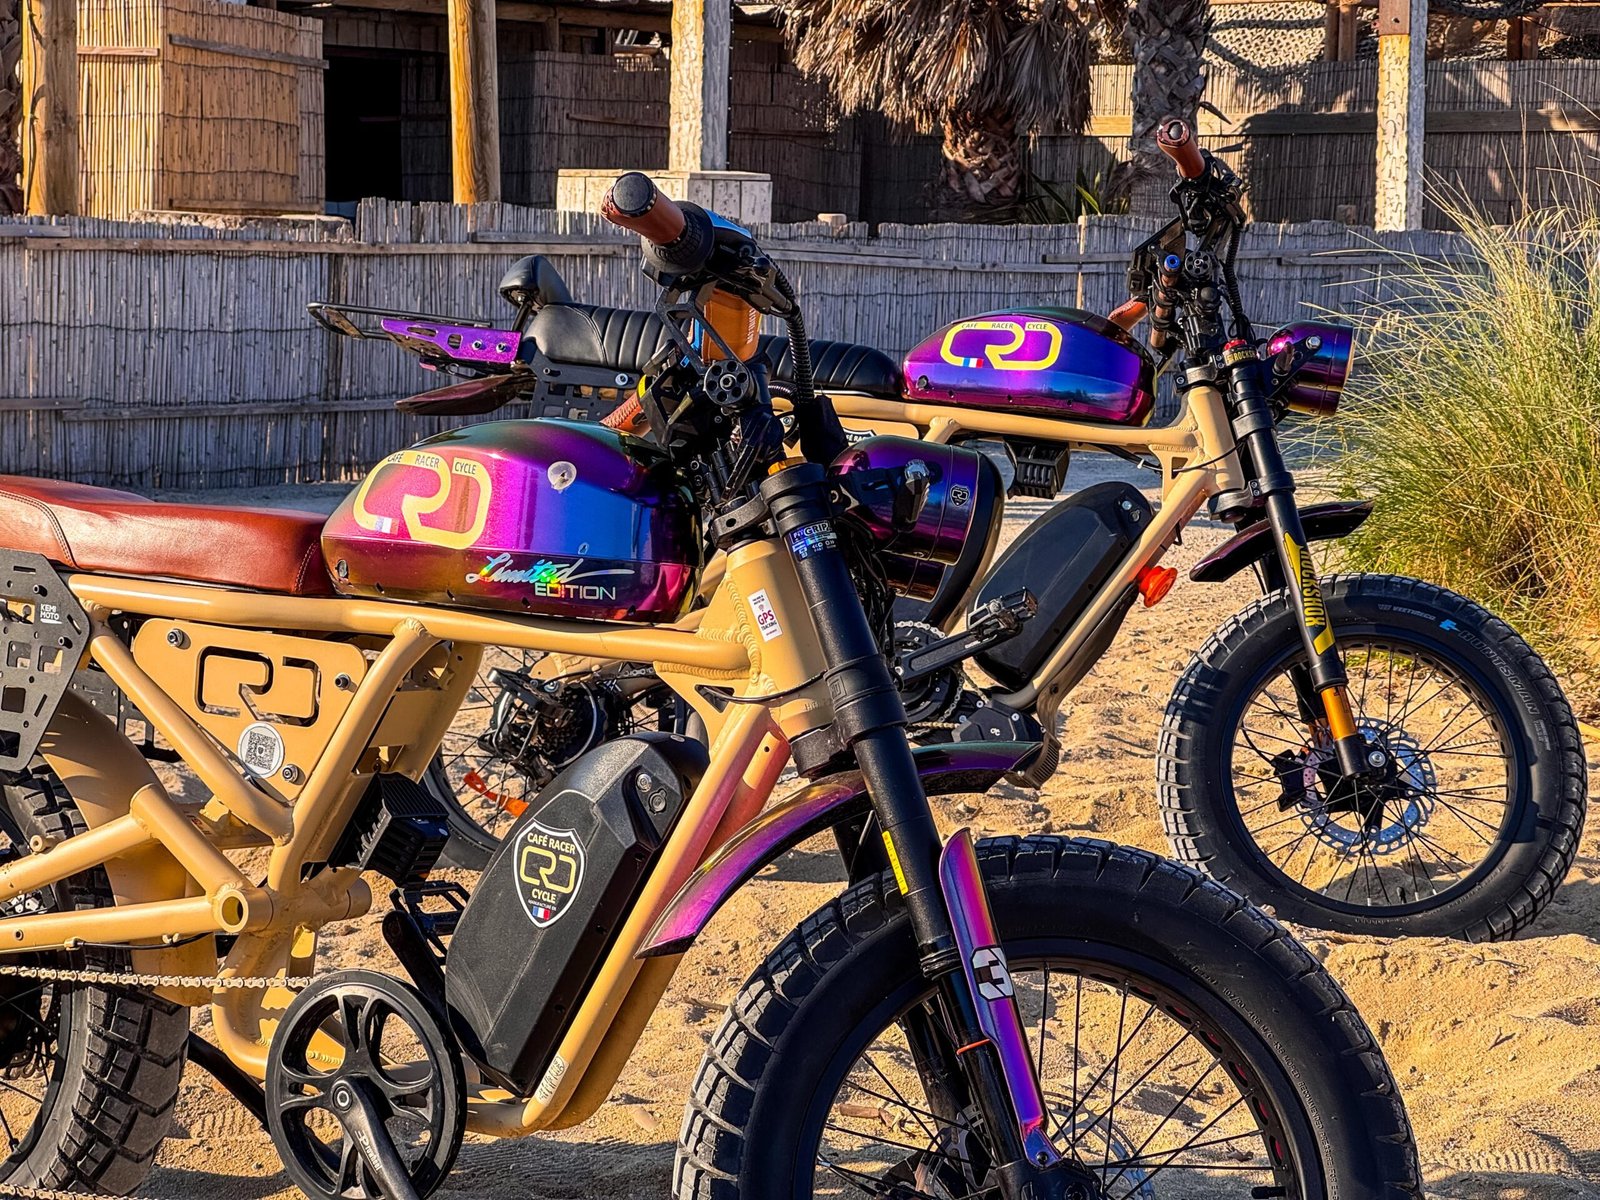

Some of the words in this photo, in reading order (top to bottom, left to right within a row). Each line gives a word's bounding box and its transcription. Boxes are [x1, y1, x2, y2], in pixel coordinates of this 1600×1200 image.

[414, 454, 440, 468] RACER
[454, 461, 477, 475] CYCLE
[465, 552, 635, 584] Limited
[534, 582, 616, 600] EDITION
[40, 603, 57, 612] KEMI
[40, 611, 60, 620] MOTO
[757, 609, 775, 625] GPS
[527, 832, 548, 847] CAFÉ
[548, 838, 576, 854] RACER
[531, 888, 557, 904] CYCLE
[1298, 1081, 1324, 1129] RECOMMENDED
[1319, 1132, 1334, 1166] PRESSURE
